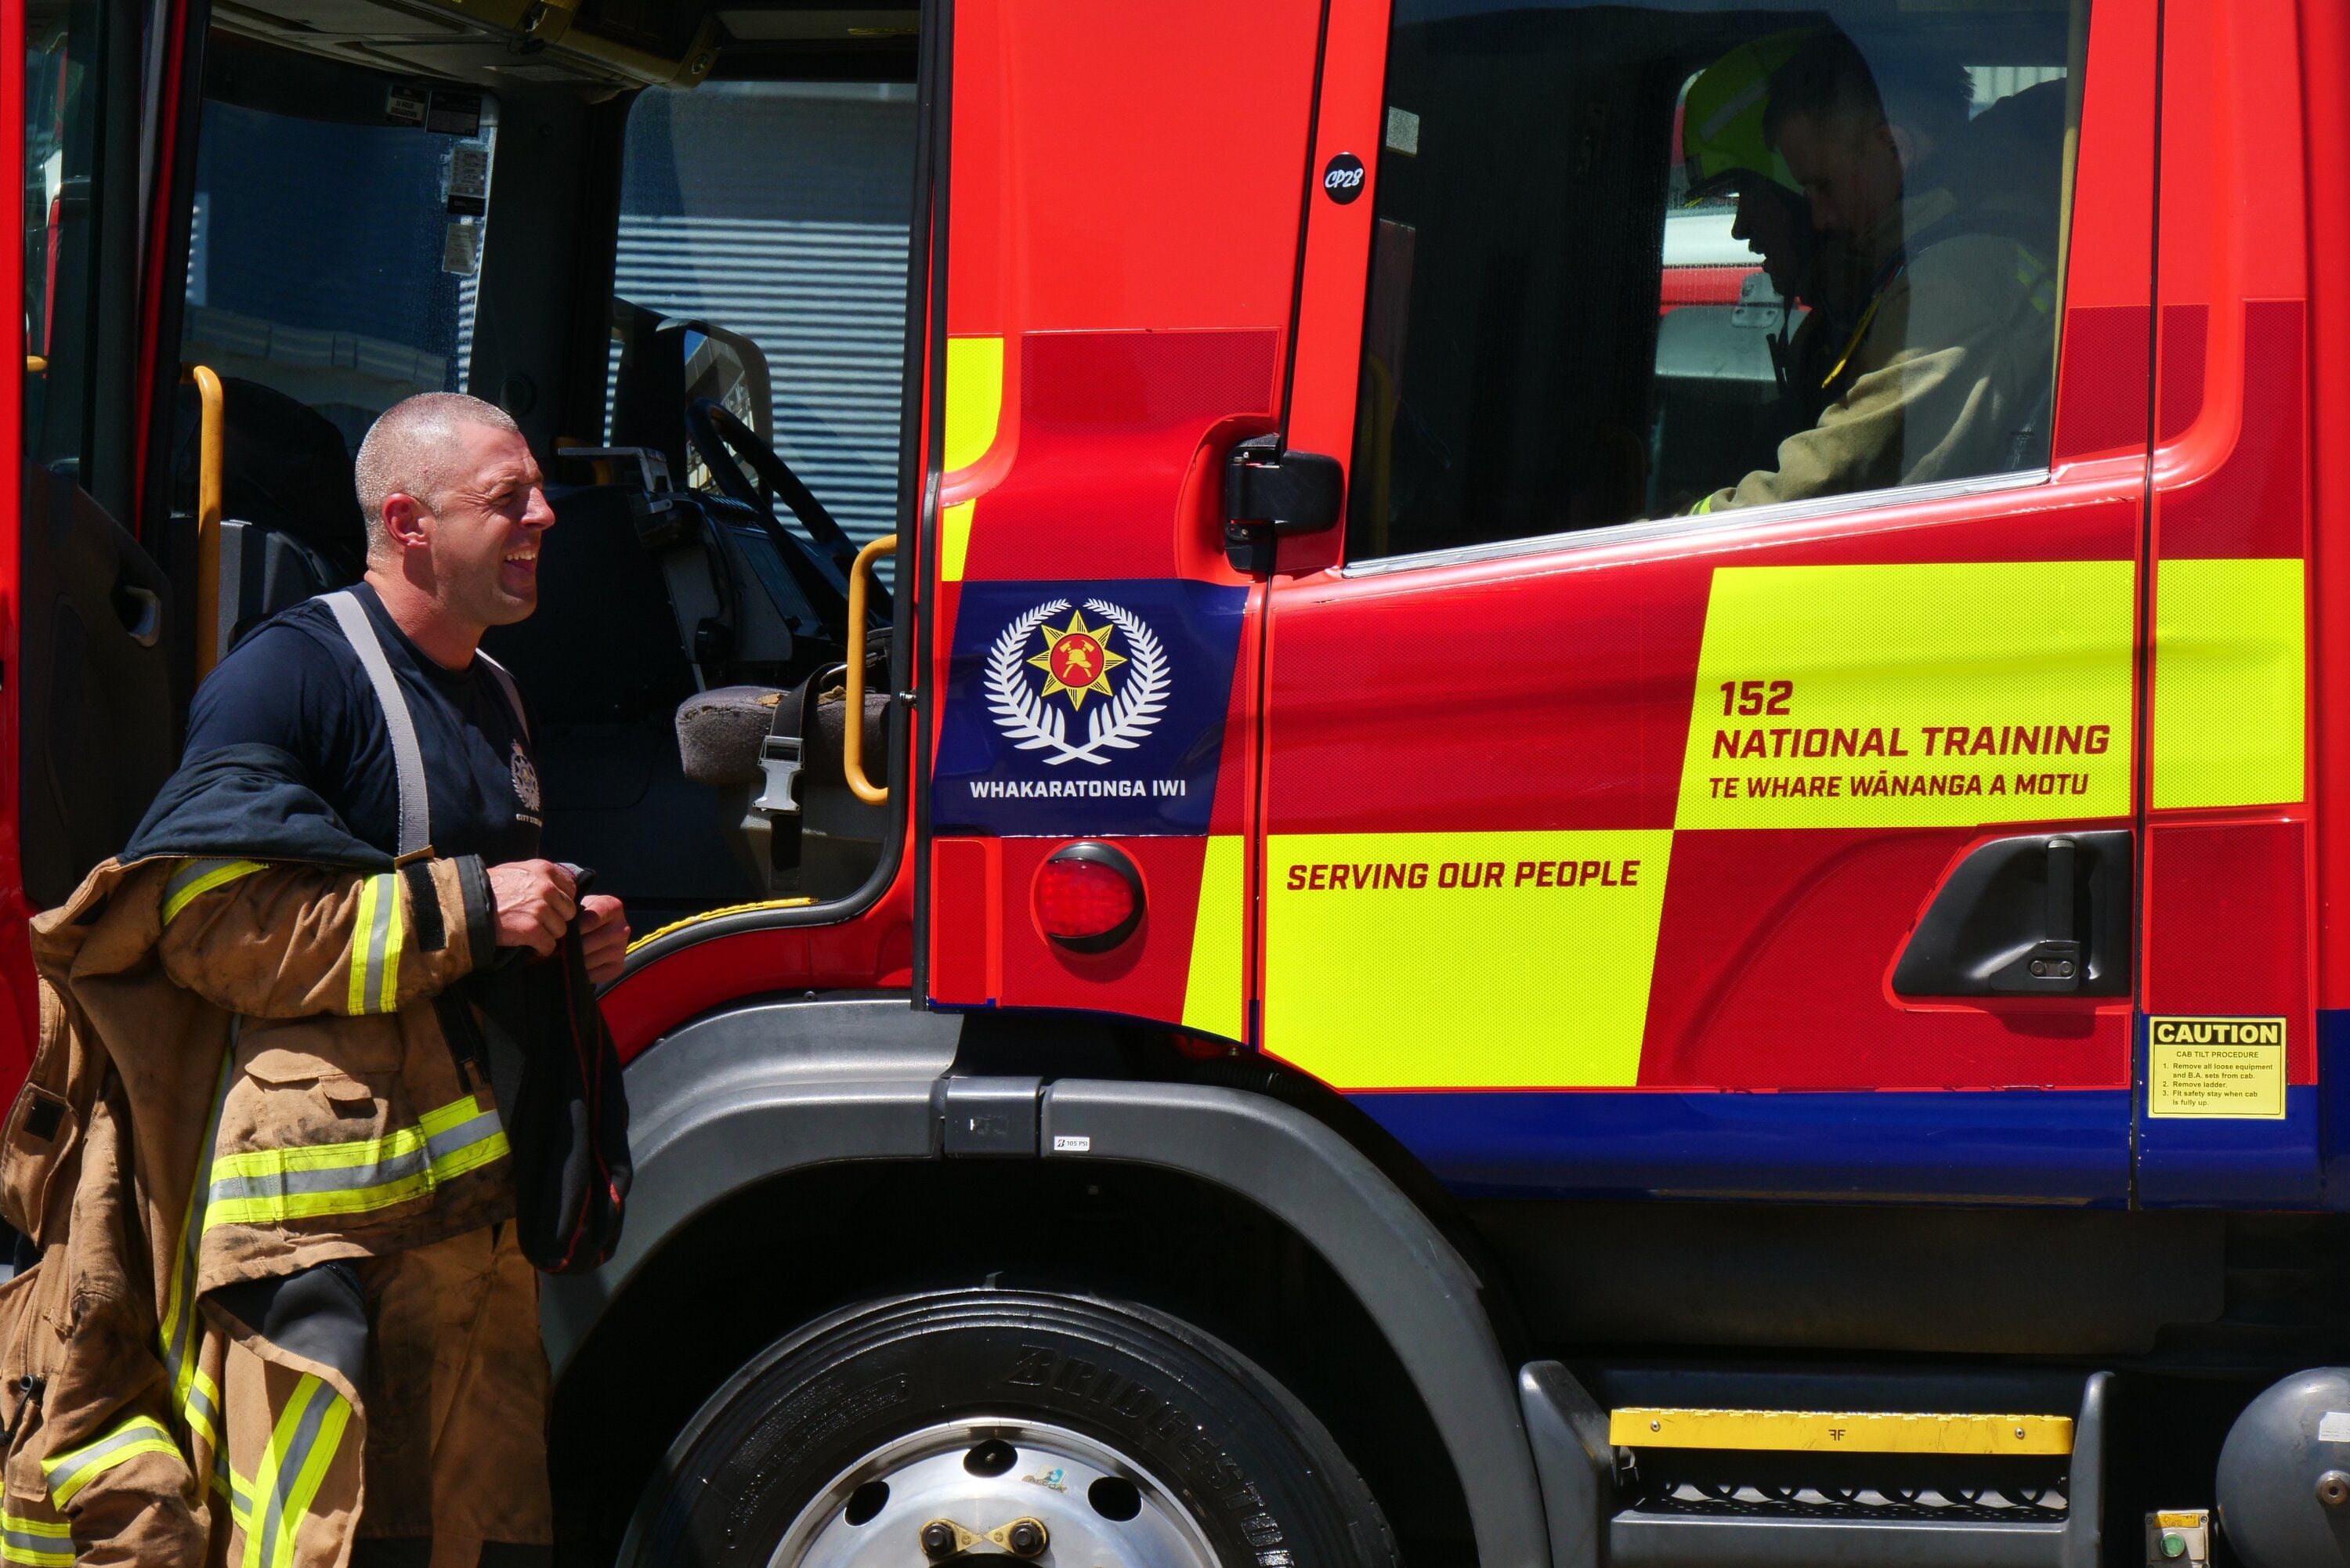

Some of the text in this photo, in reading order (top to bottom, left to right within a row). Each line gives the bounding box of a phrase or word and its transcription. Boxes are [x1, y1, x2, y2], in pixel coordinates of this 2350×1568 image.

[1325, 168, 1364, 188] CP28
[1720, 680, 1793, 717] 152
[1712, 725, 2110, 759] NATIONAL TRAINING
[970, 779, 1186, 798] WHAKARATONGA IWI
[1709, 770, 2088, 799] TE WHARE WĀNANGA A MOTU
[515, 814, 530, 822] CITY
[1286, 860, 1641, 891] SERVING OUR PEOPLE
[2157, 1024, 2278, 1043] CAUTION
[2181, 1099, 2196, 1107] fully
